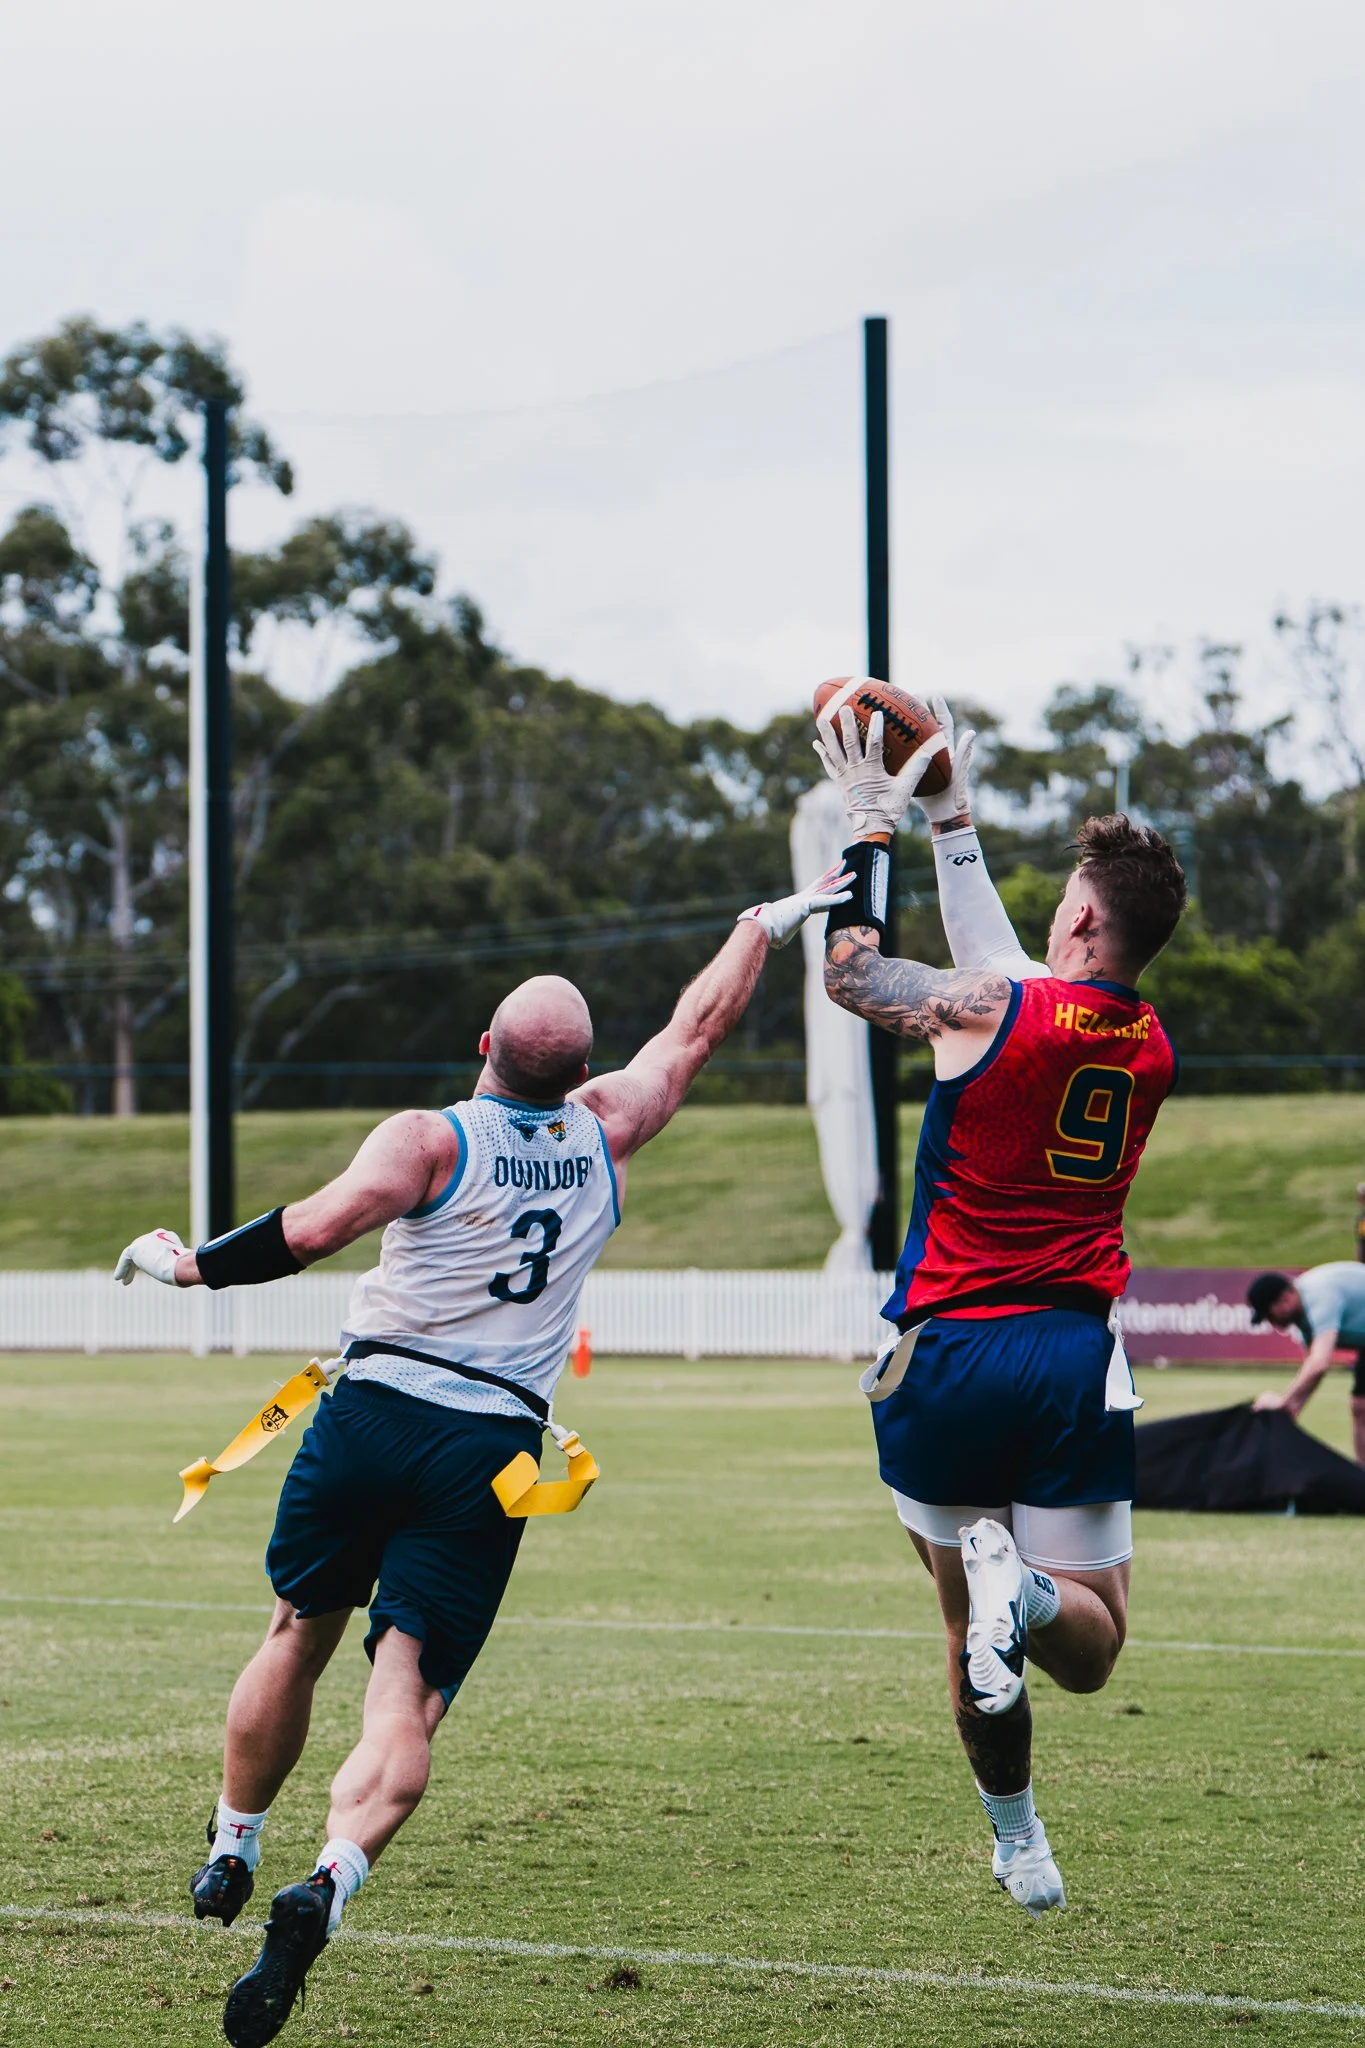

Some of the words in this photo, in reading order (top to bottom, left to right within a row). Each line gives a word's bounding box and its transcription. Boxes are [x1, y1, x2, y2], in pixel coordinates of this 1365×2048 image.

[1054, 1003, 1151, 1039] HELLERS
[1045, 1063, 1135, 1183] 9
[488, 1208, 562, 1304] 3
